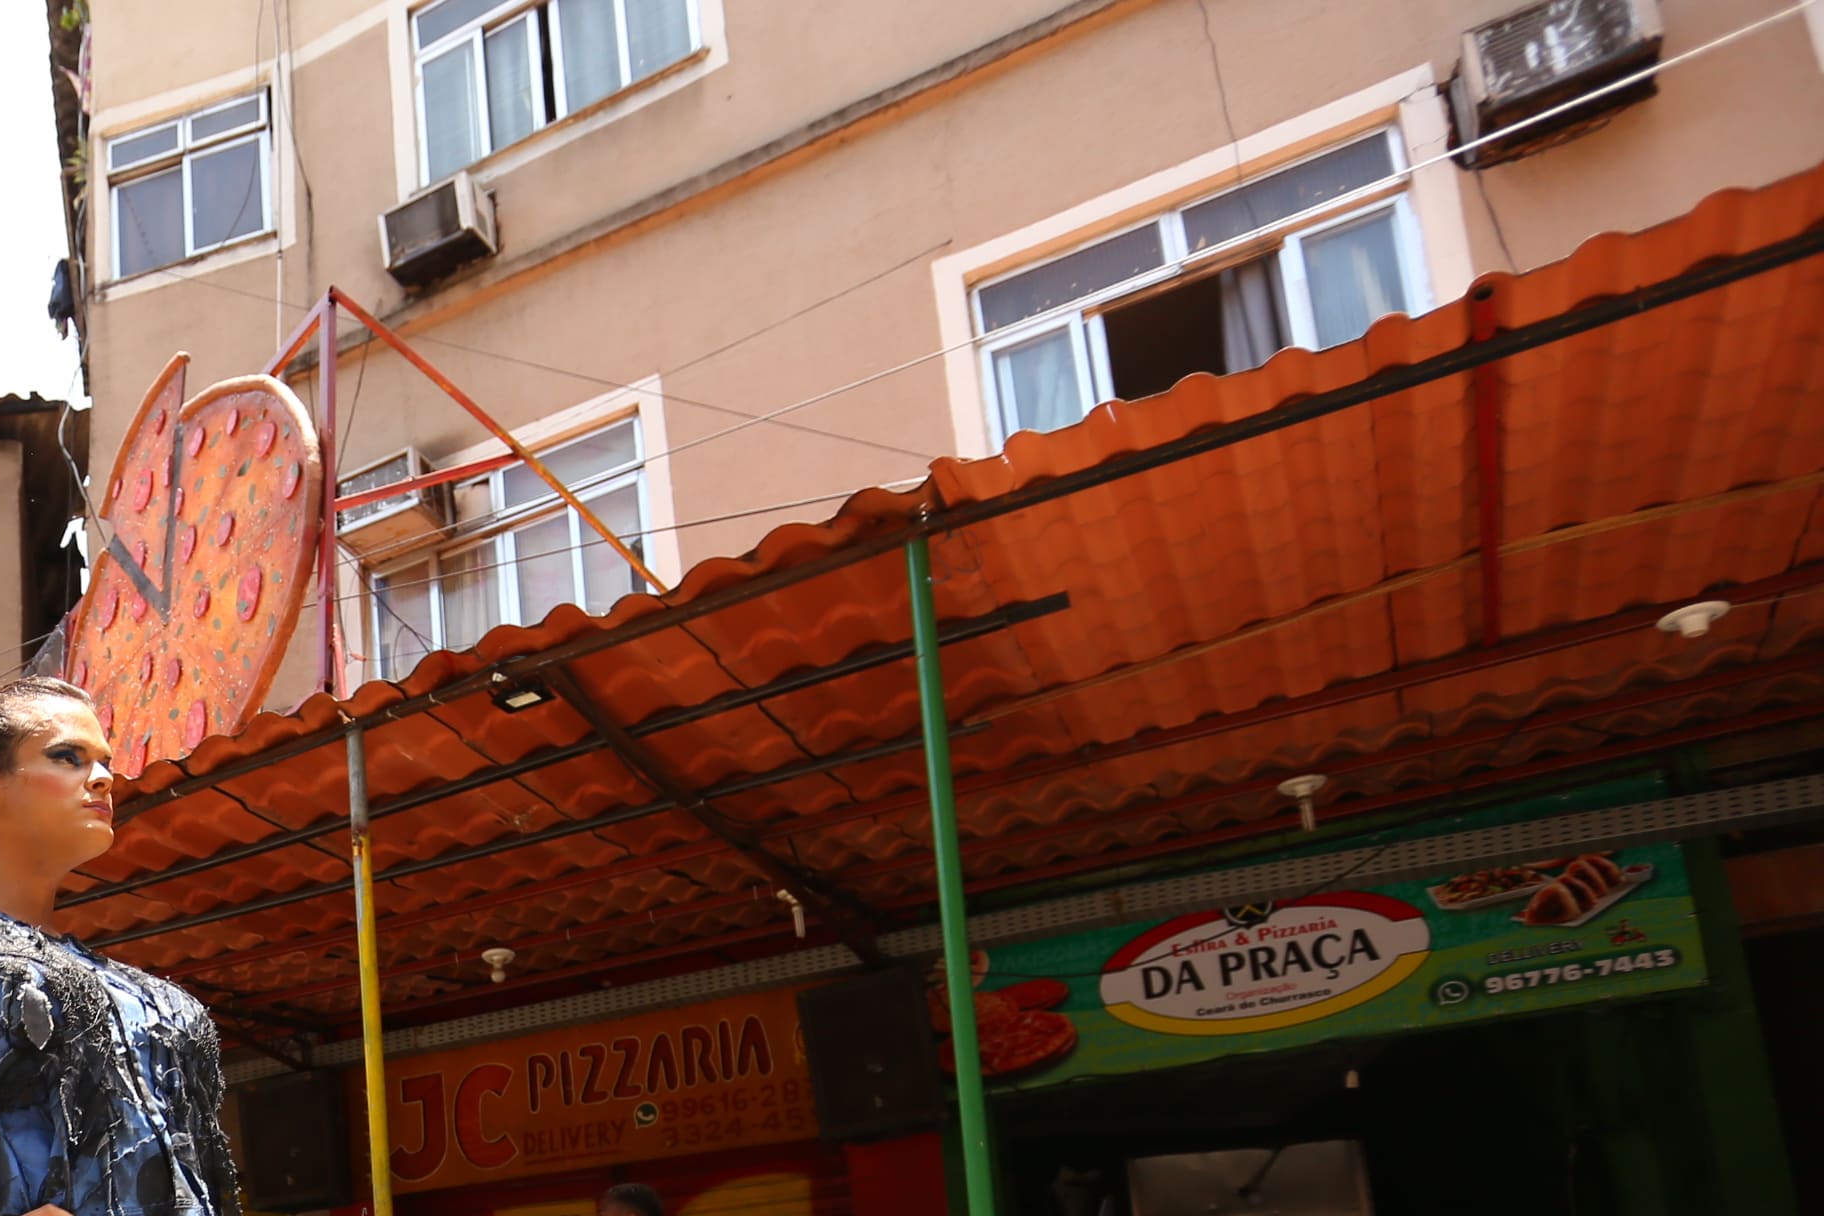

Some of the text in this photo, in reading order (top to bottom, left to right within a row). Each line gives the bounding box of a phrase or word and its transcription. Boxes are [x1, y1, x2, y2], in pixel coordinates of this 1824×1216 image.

[1235, 931, 1250, 946] &
[1142, 927, 1380, 1000] DA PRAÇA
[1482, 948, 1677, 996] 96776-7443
[389, 1014, 774, 1184] JC PIZZARIA
[522, 1117, 628, 1158] DELIVERY
